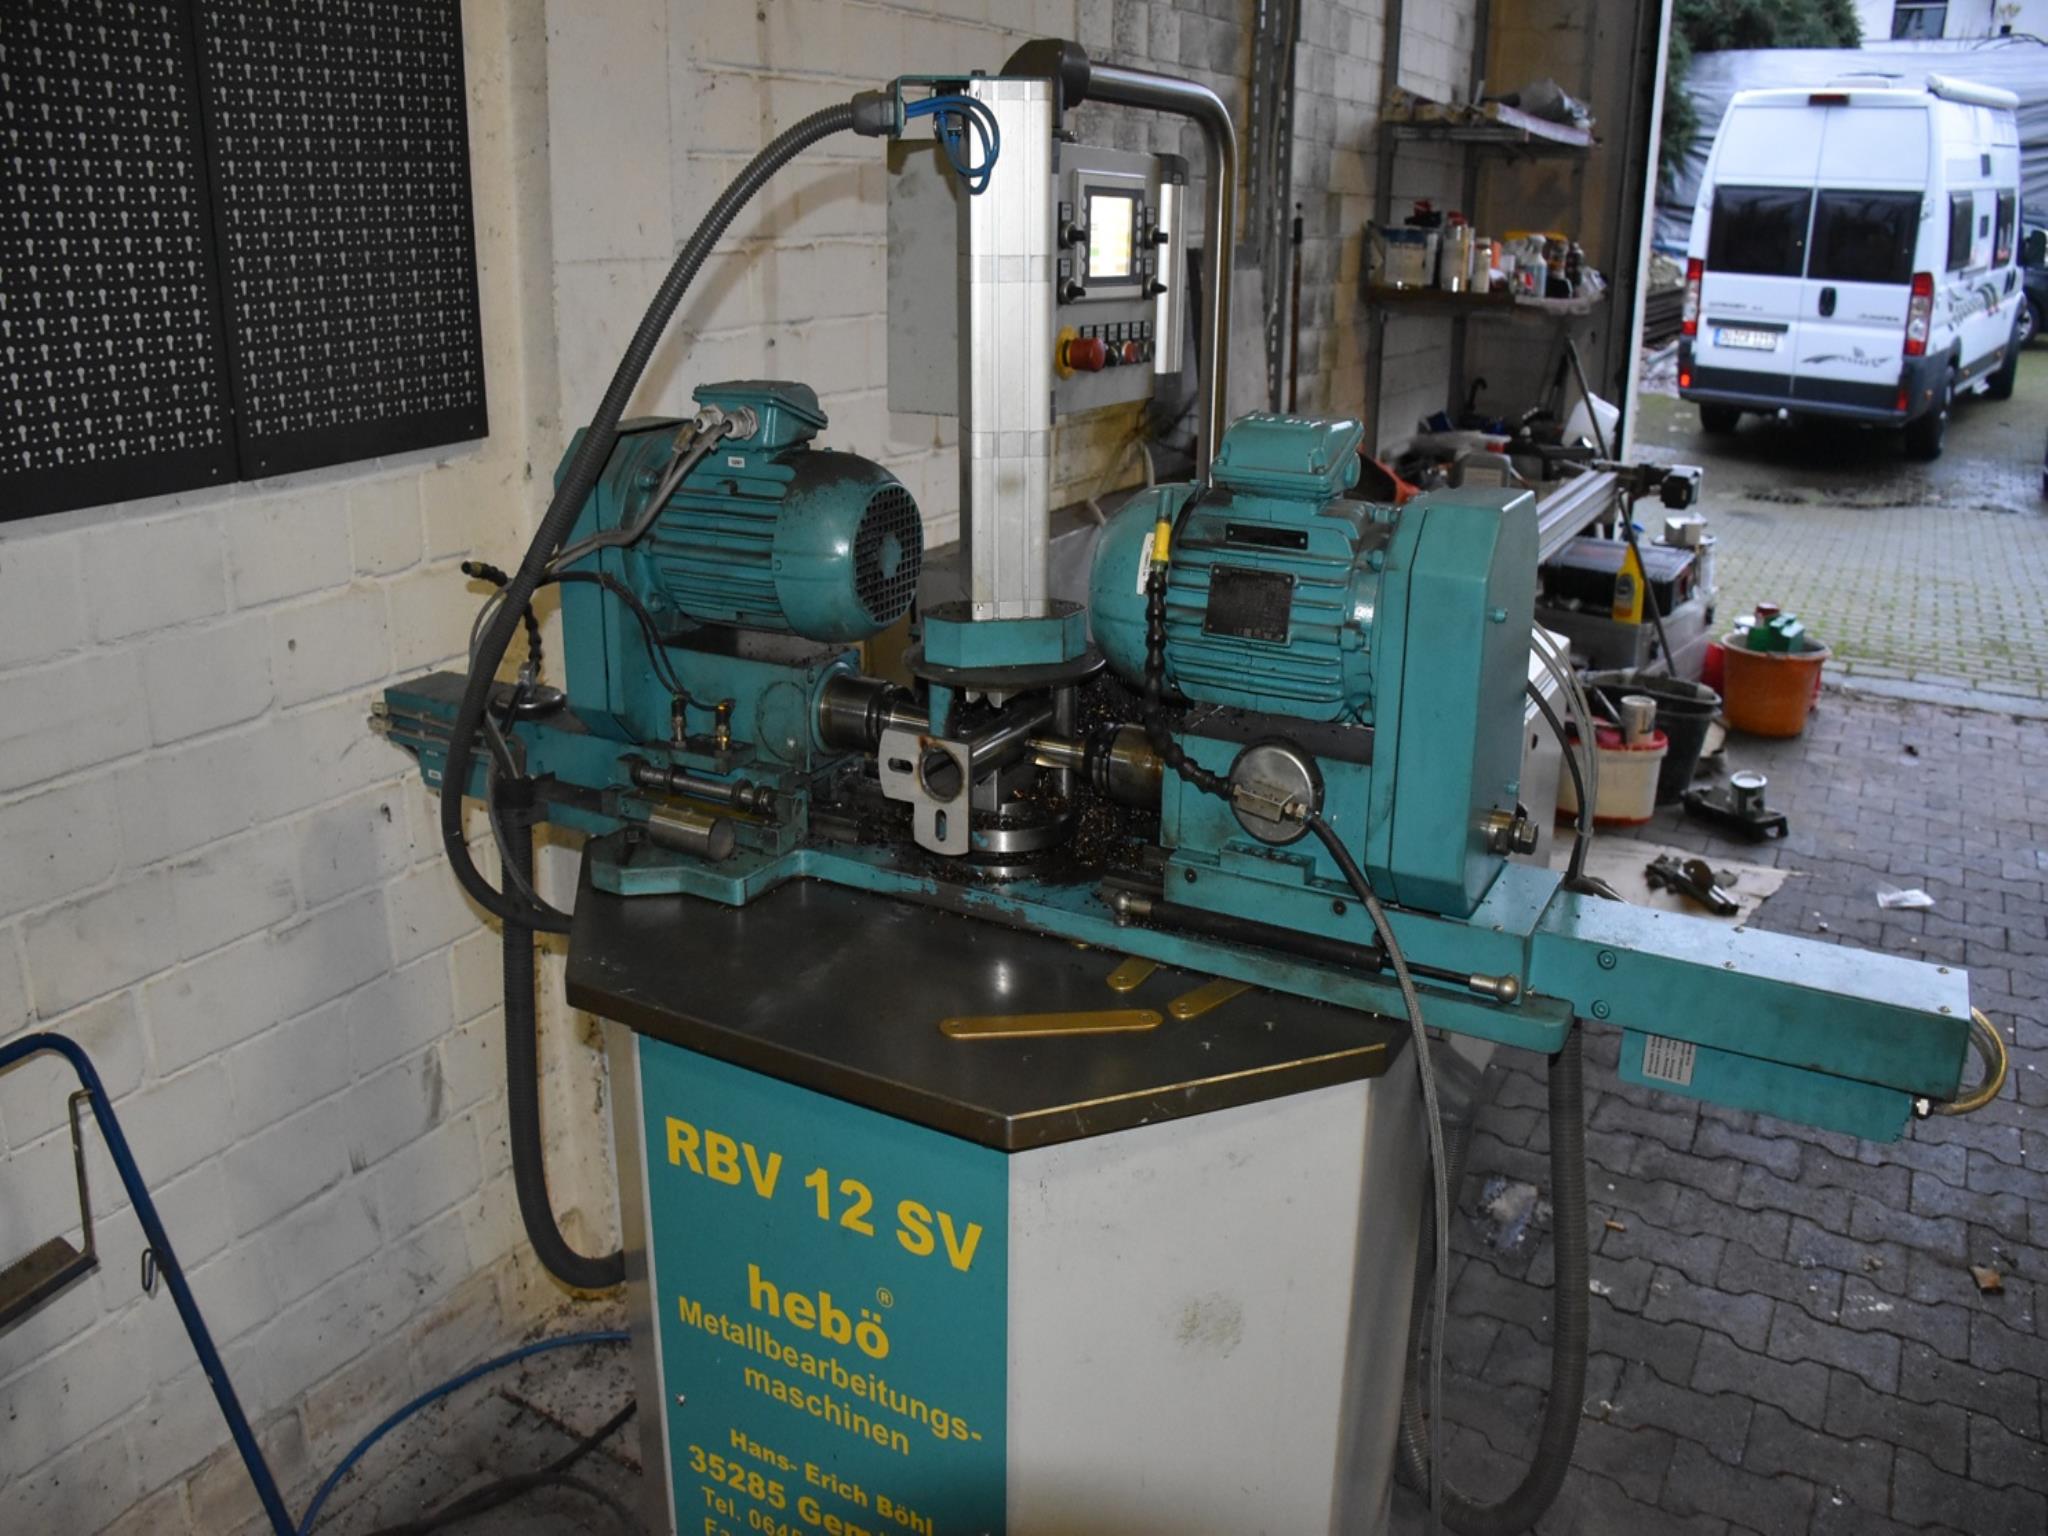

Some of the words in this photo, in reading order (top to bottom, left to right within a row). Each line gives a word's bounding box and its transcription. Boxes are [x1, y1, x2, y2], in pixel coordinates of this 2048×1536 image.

[665, 1115, 783, 1199] RBV
[804, 1167, 876, 1237] 12
[896, 1199, 984, 1272] SV
[747, 1263, 890, 1360] hebö
[678, 1295, 982, 1442] Metallbearbeitungs-
[744, 1367, 910, 1456] maschinen
[688, 1444, 787, 1510] 35285
[701, 1485, 742, 1522] Tel.
[730, 1429, 798, 1471] Hans-
[804, 1462, 869, 1507] Erich
[876, 1494, 933, 1536] Böhl
